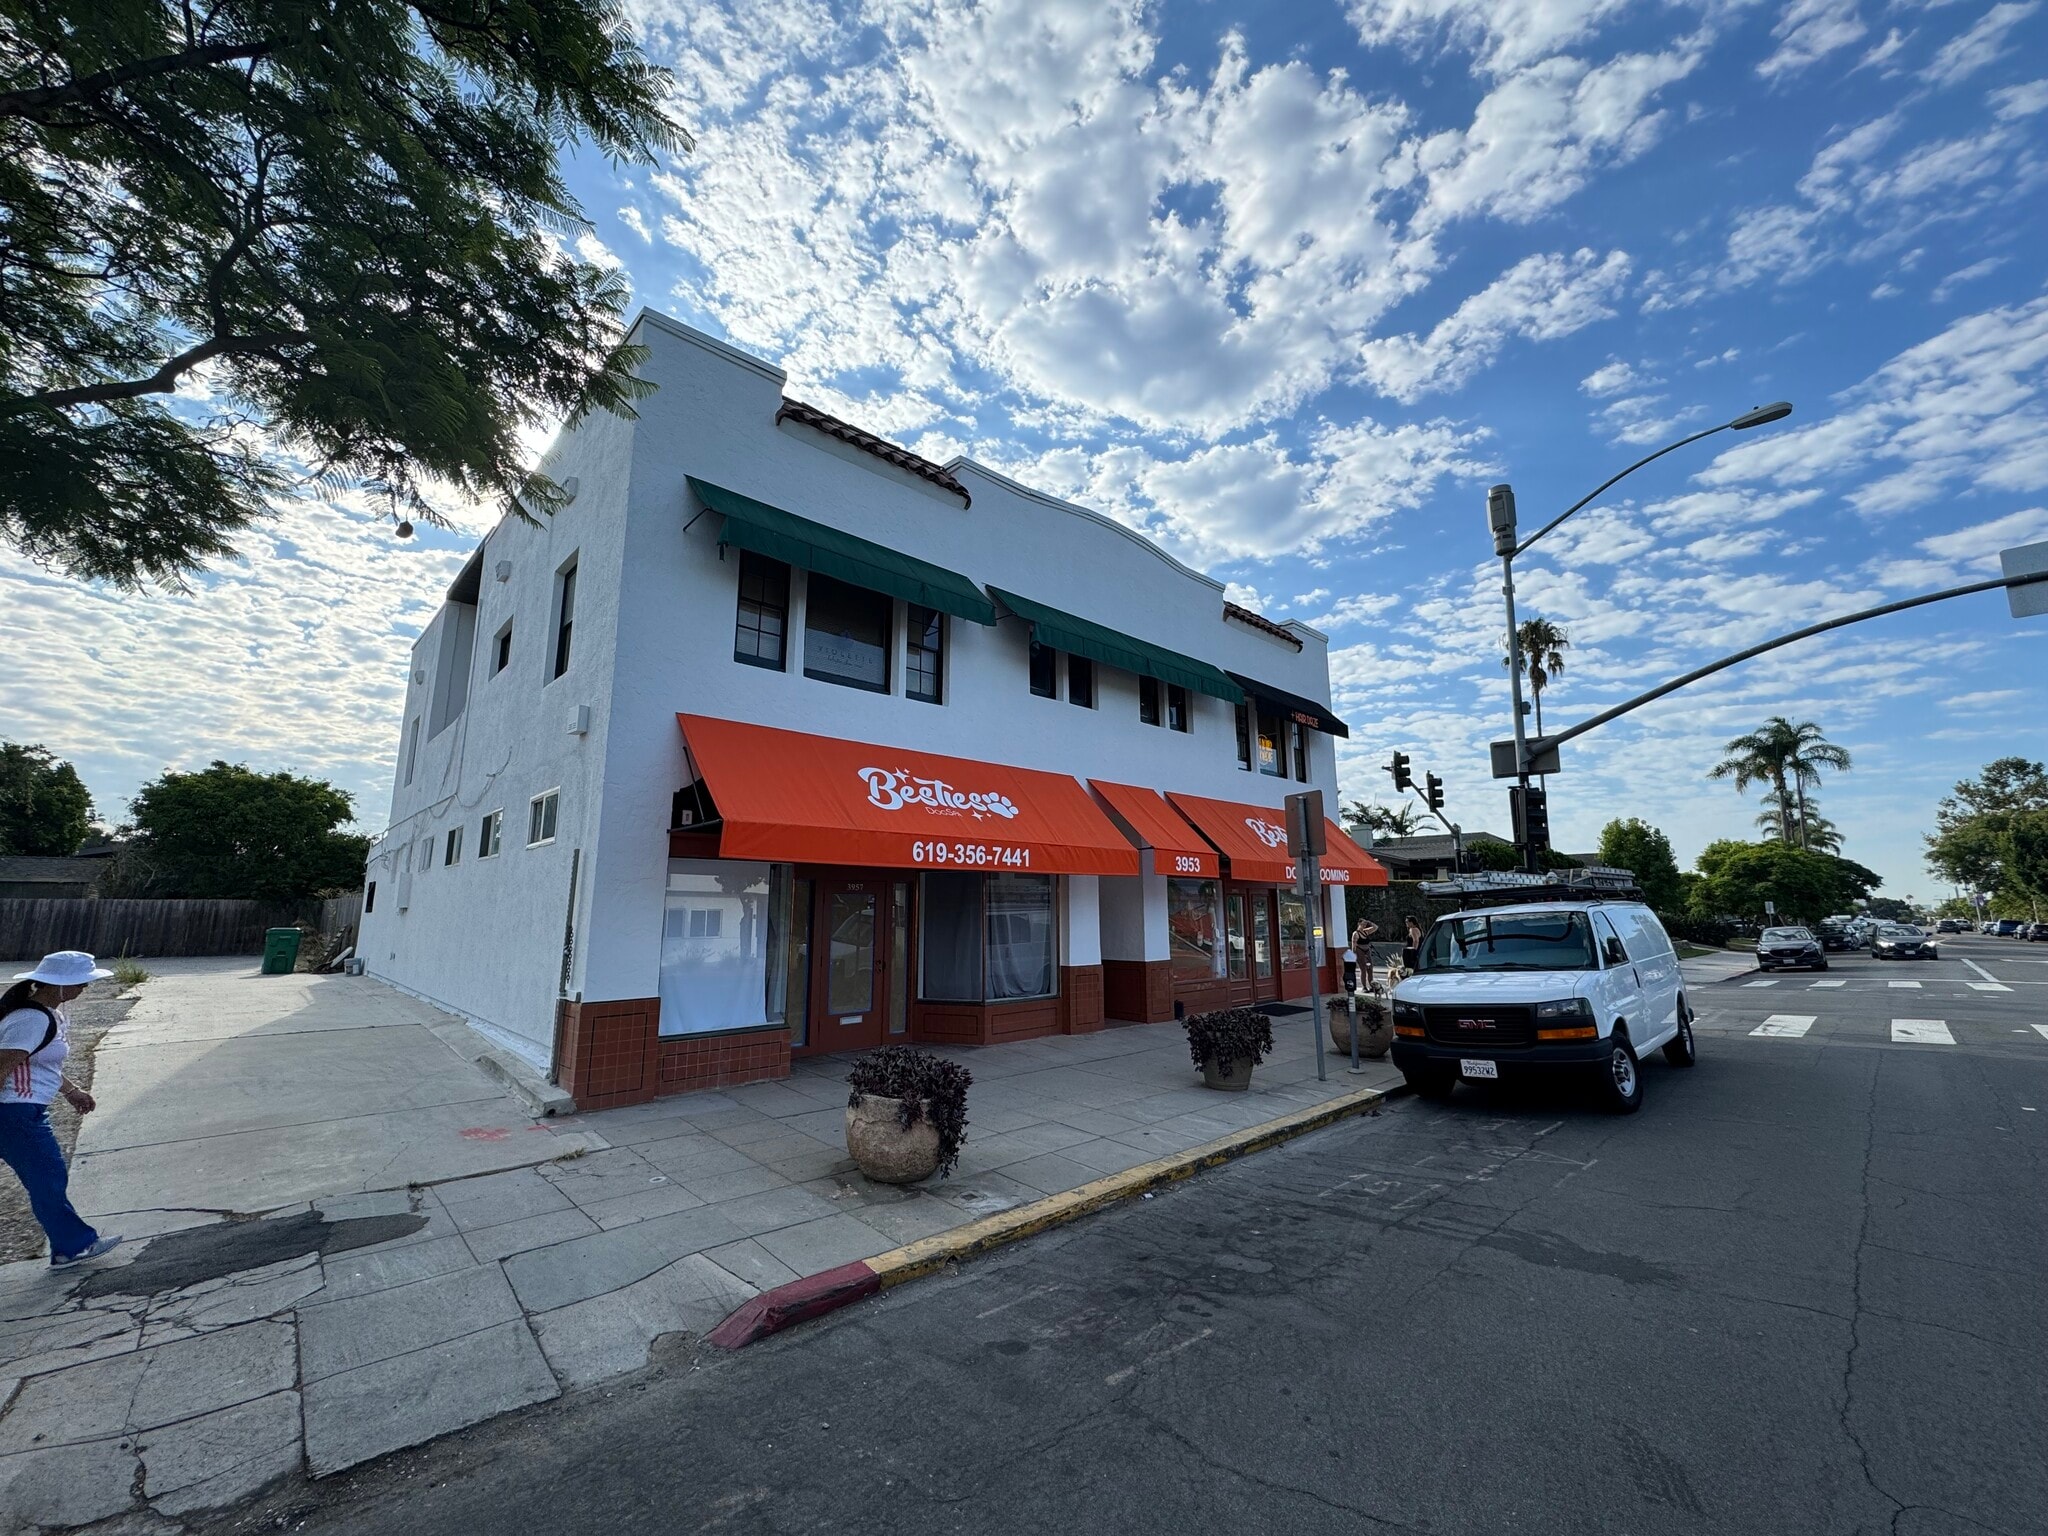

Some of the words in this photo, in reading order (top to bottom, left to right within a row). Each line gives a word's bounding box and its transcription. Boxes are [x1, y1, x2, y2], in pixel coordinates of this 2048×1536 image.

[857, 766, 988, 811] Besties
[912, 840, 1031, 867] 619-356-7441
[1175, 855, 1201, 872] 3953
[1457, 1019, 1496, 1029] GMC
